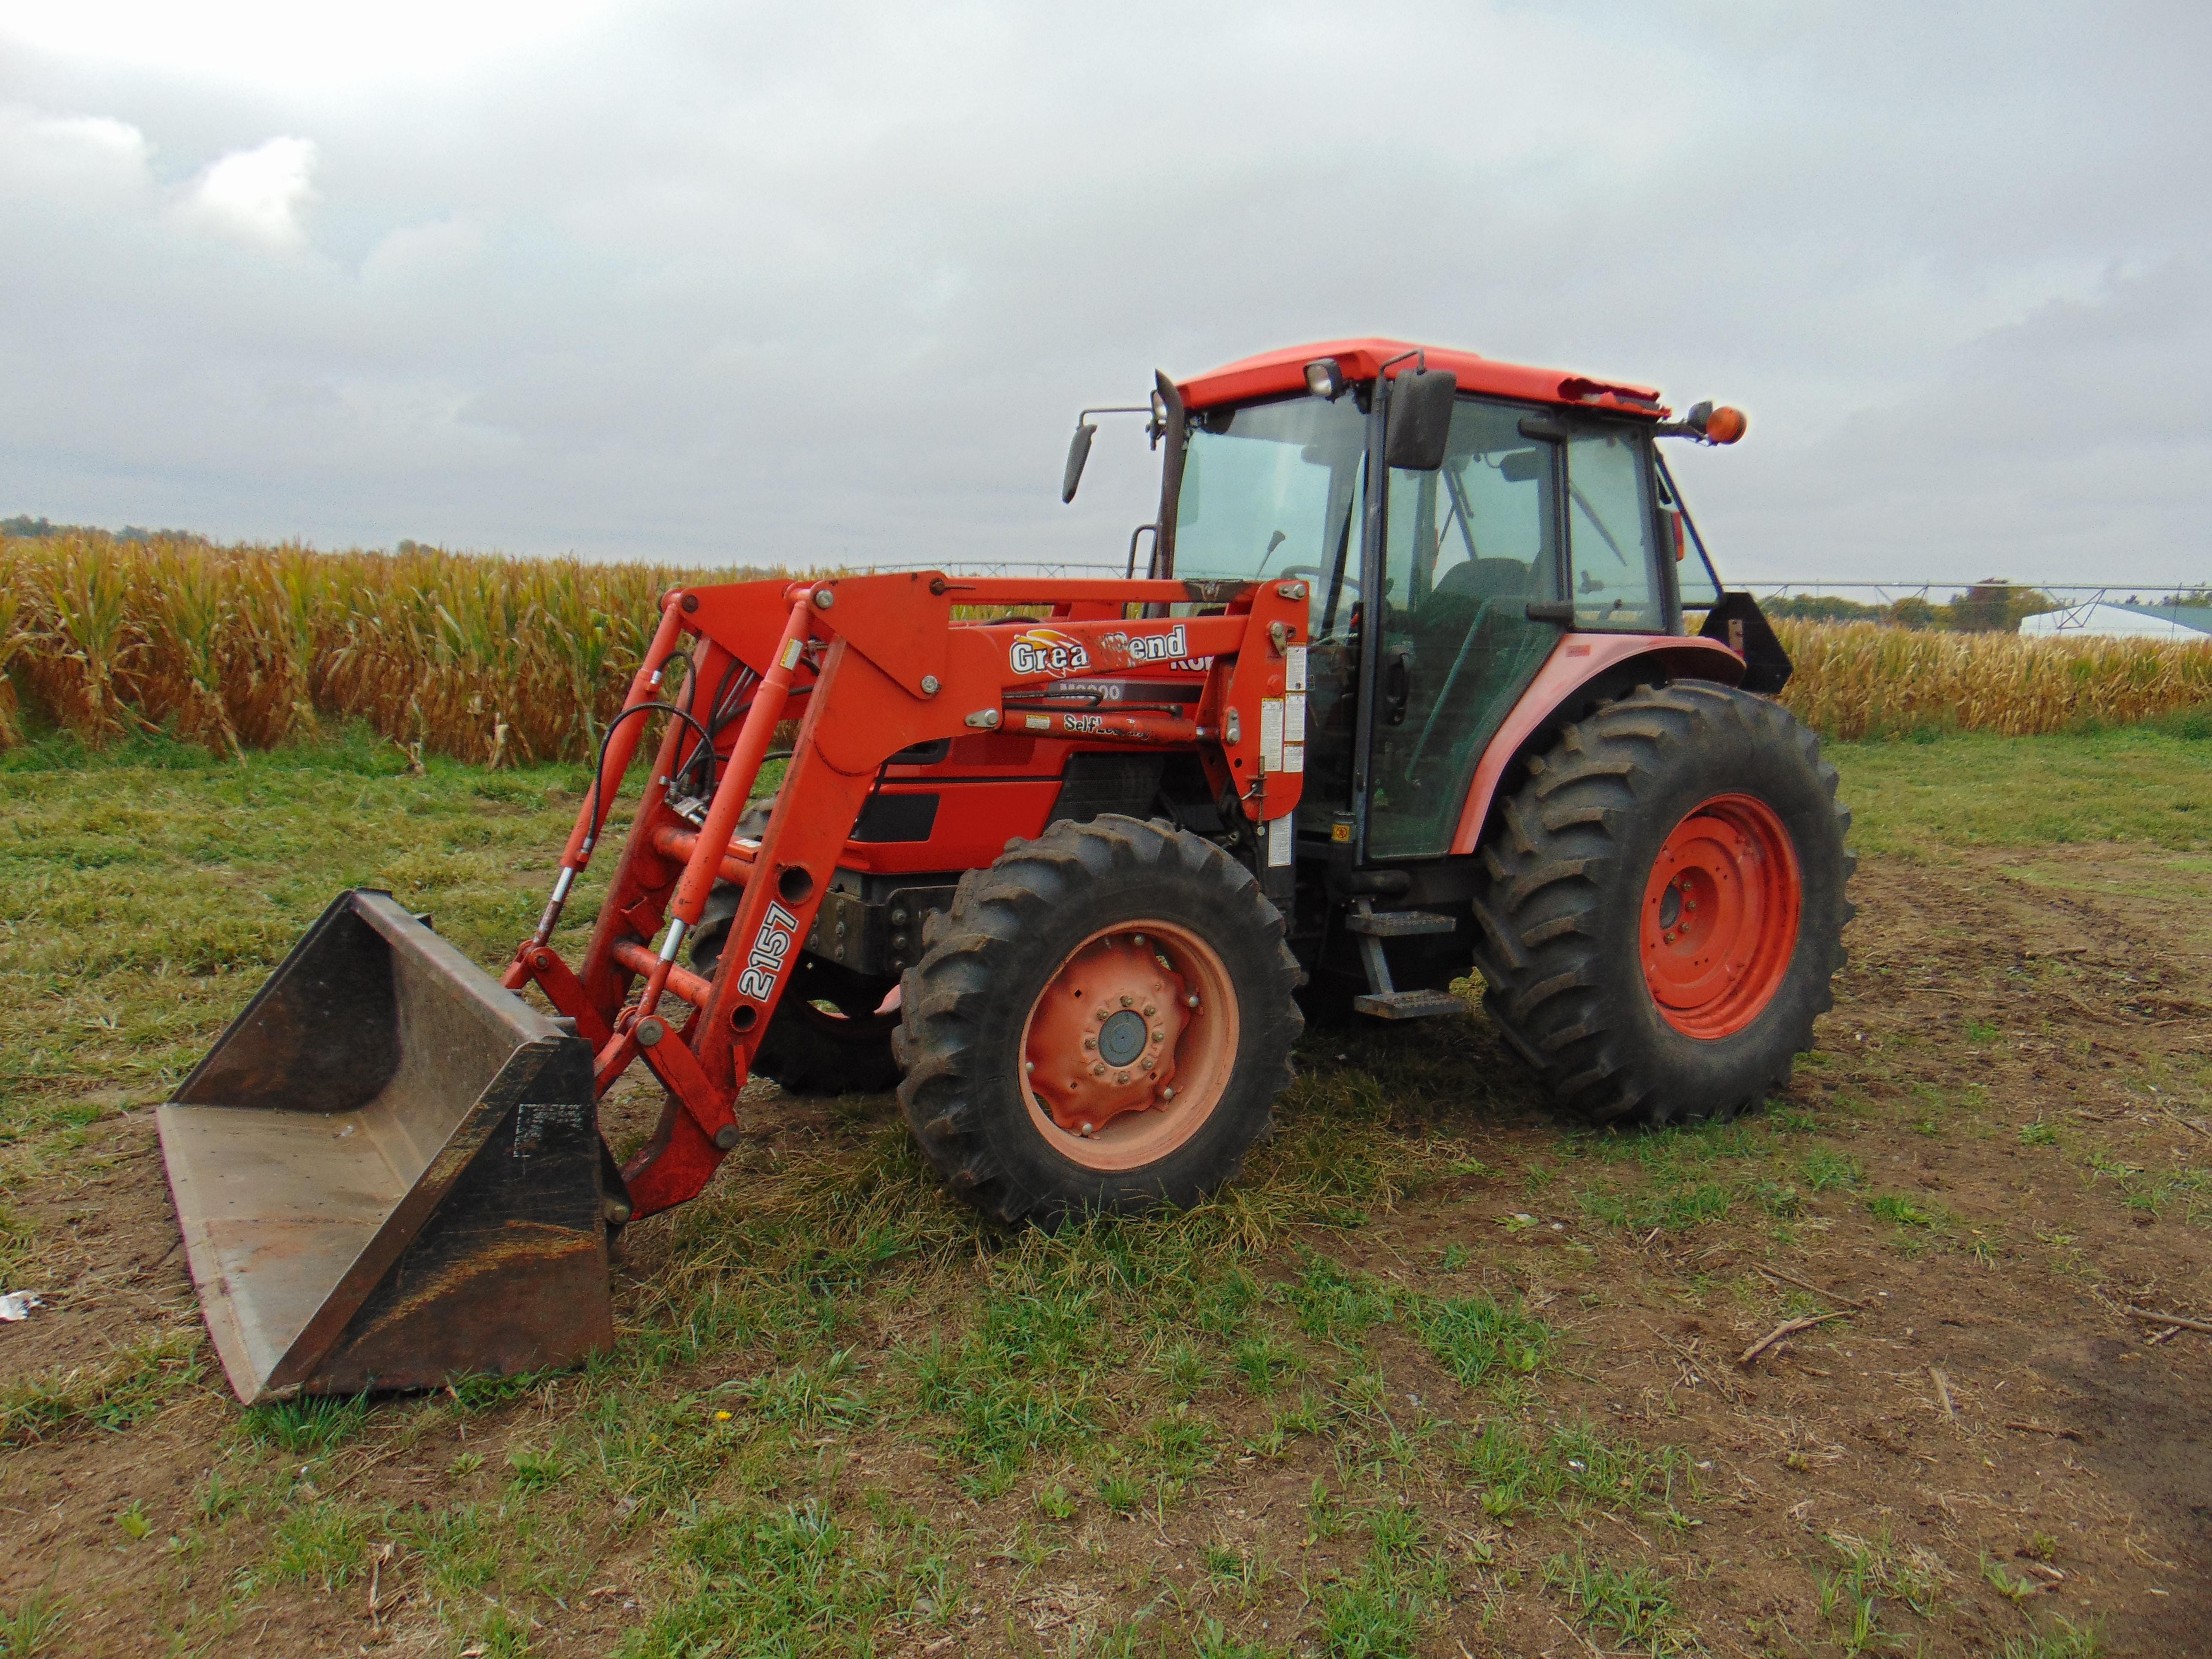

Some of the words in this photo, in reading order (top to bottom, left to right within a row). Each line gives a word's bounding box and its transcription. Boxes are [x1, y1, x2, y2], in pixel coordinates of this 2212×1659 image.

[1010, 641, 1093, 675] Grea
[1064, 714, 1096, 733] Self
[738, 900, 799, 1003] 2157
